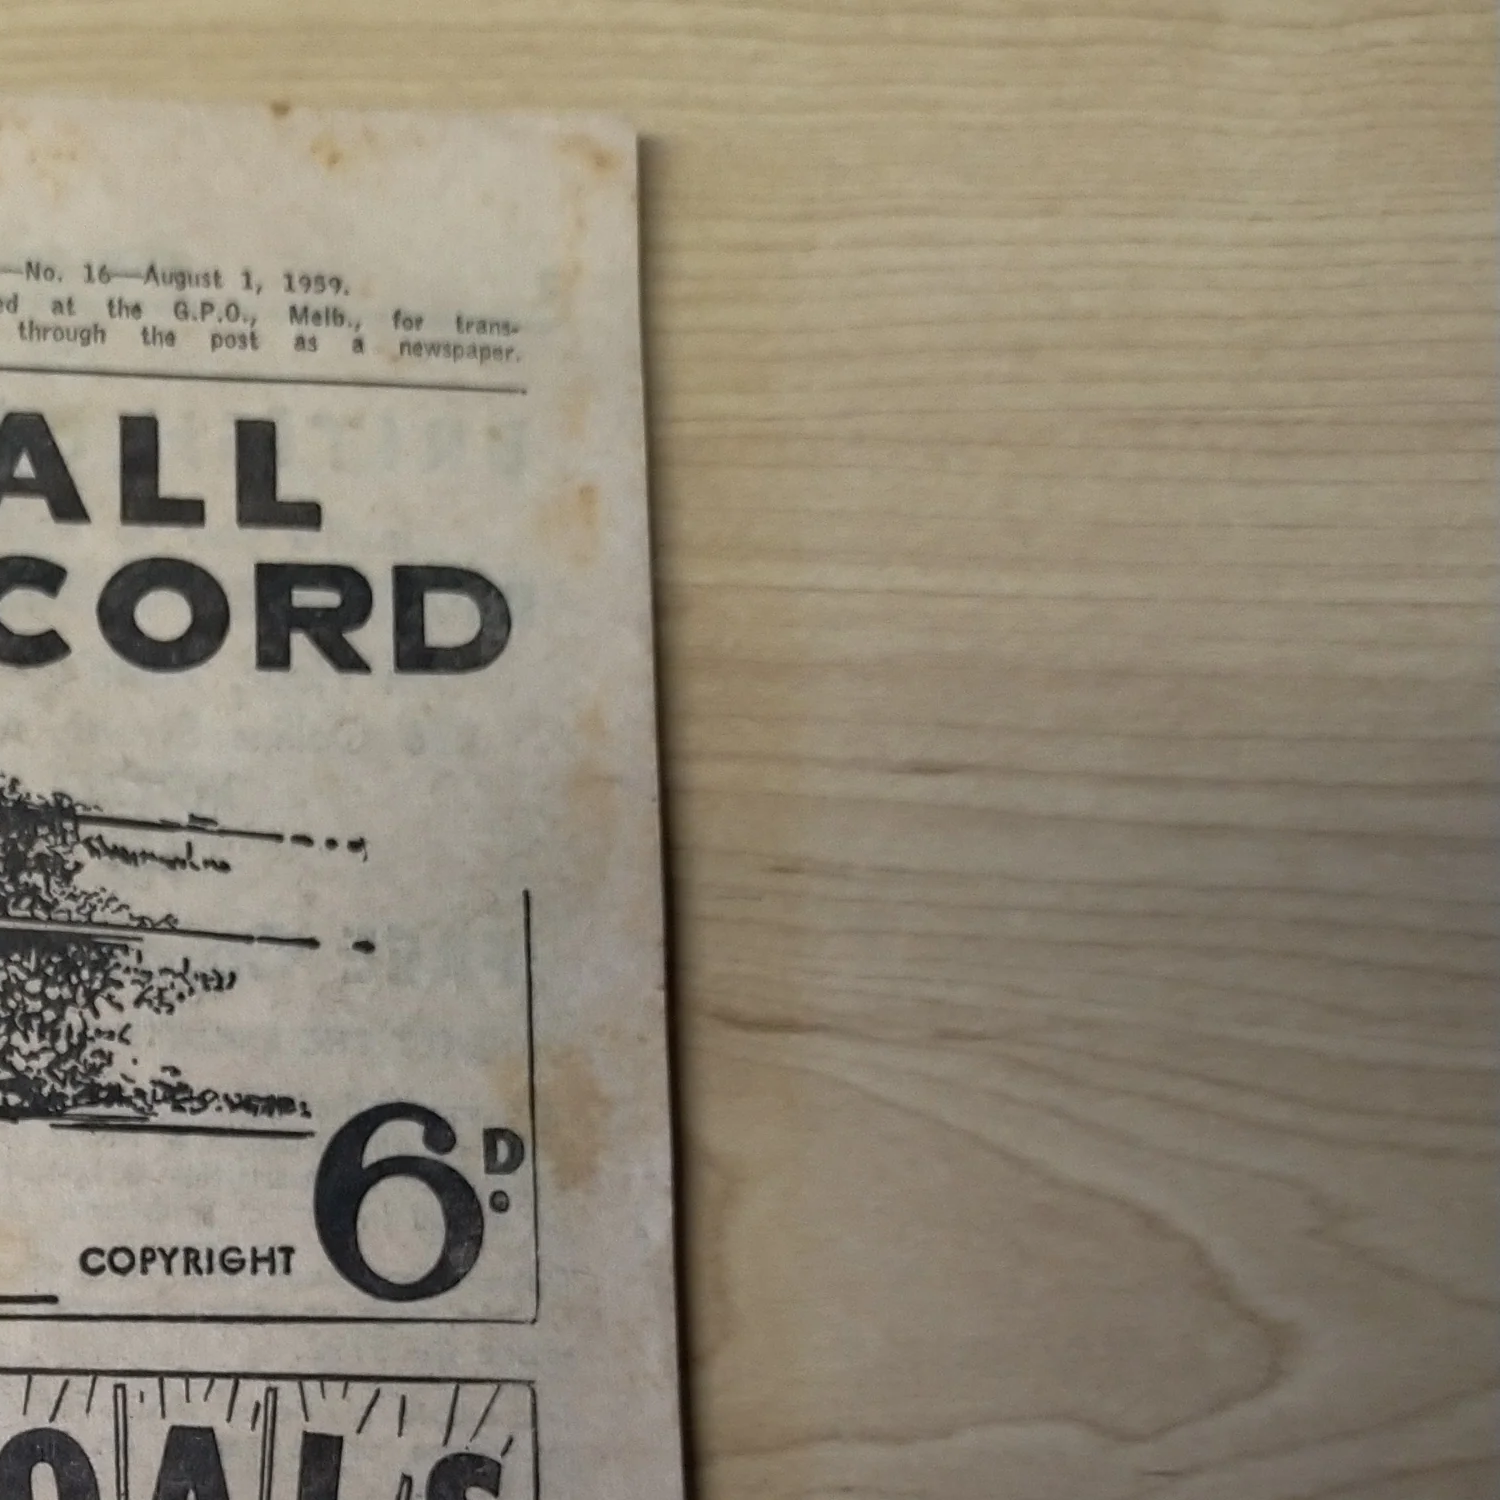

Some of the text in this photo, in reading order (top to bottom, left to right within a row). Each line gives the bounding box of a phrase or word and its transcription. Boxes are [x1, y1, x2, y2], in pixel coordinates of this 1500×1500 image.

[51, 298, 76, 316] at
[107, 298, 142, 320] the
[393, 309, 423, 331] for
[19, 320, 106, 347] through
[142, 326, 176, 348] the
[211, 332, 258, 353] post
[294, 335, 318, 352] as
[352, 337, 364, 354] a
[400, 339, 520, 365] newspaper.
[79, 1246, 295, 1277] COPYRIGHT
